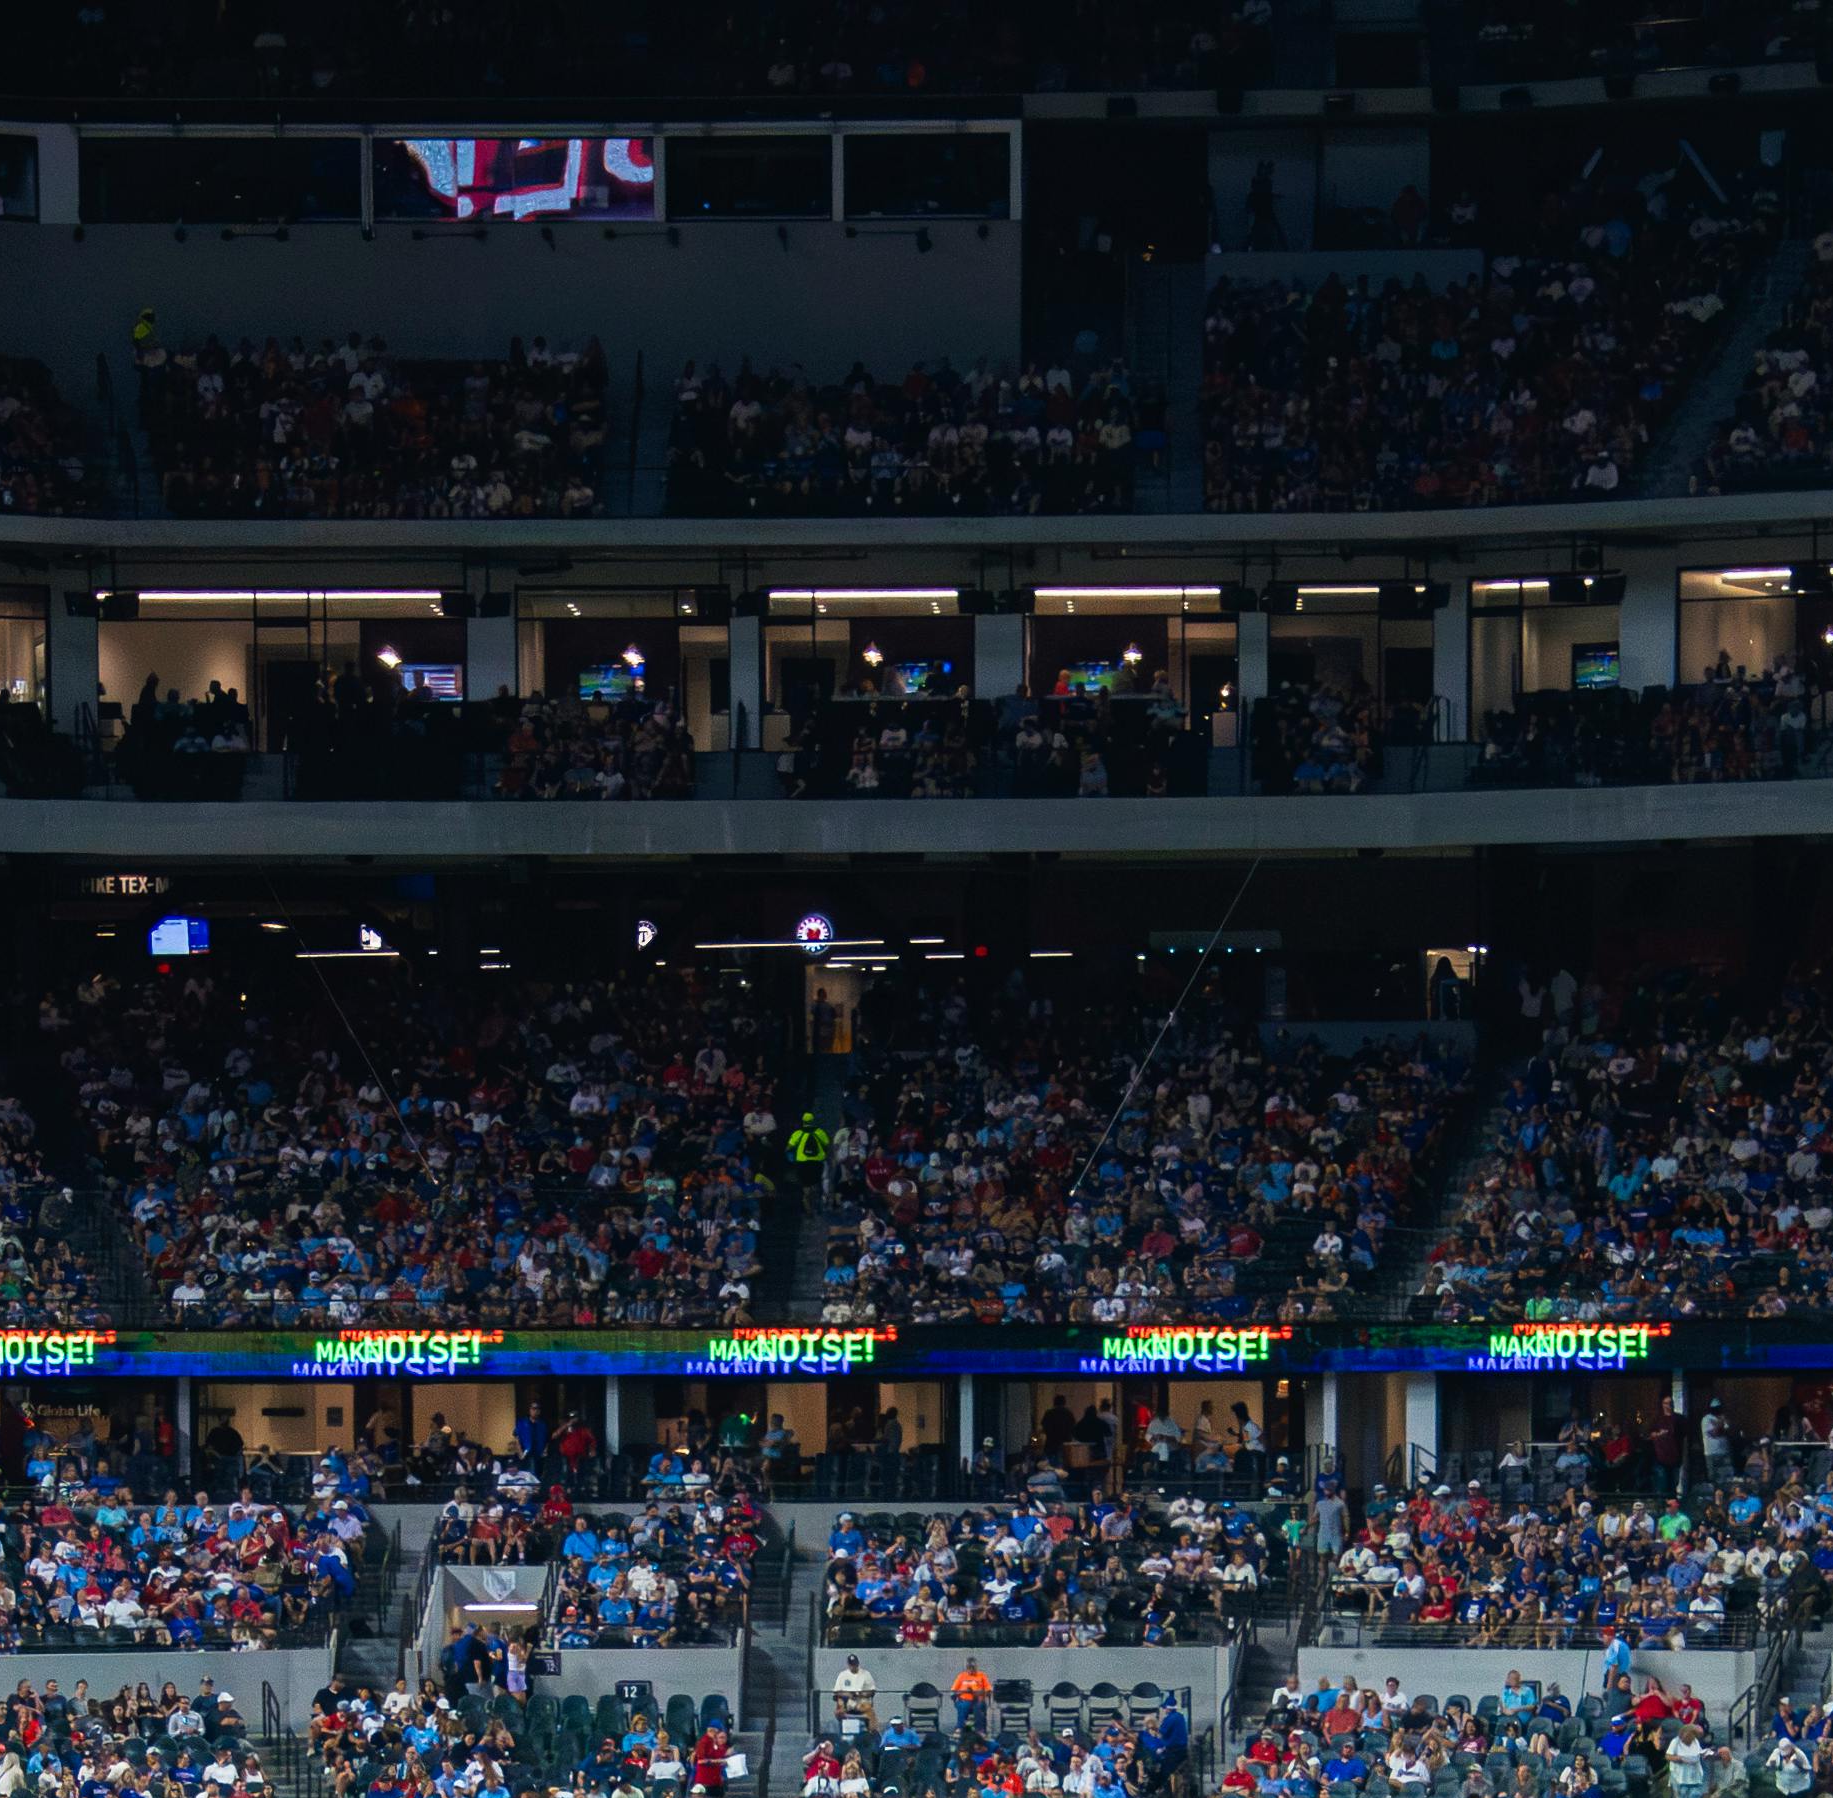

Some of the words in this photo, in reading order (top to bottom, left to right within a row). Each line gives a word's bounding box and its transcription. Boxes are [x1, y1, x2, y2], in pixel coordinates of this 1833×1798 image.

[364, 1335, 480, 1364] NOISE!
[758, 1334, 874, 1362] NOISE!
[1153, 1332, 1268, 1360] NOISE!
[1536, 1329, 1648, 1358] NOISE!
[623, 1685, 638, 1698] 12
